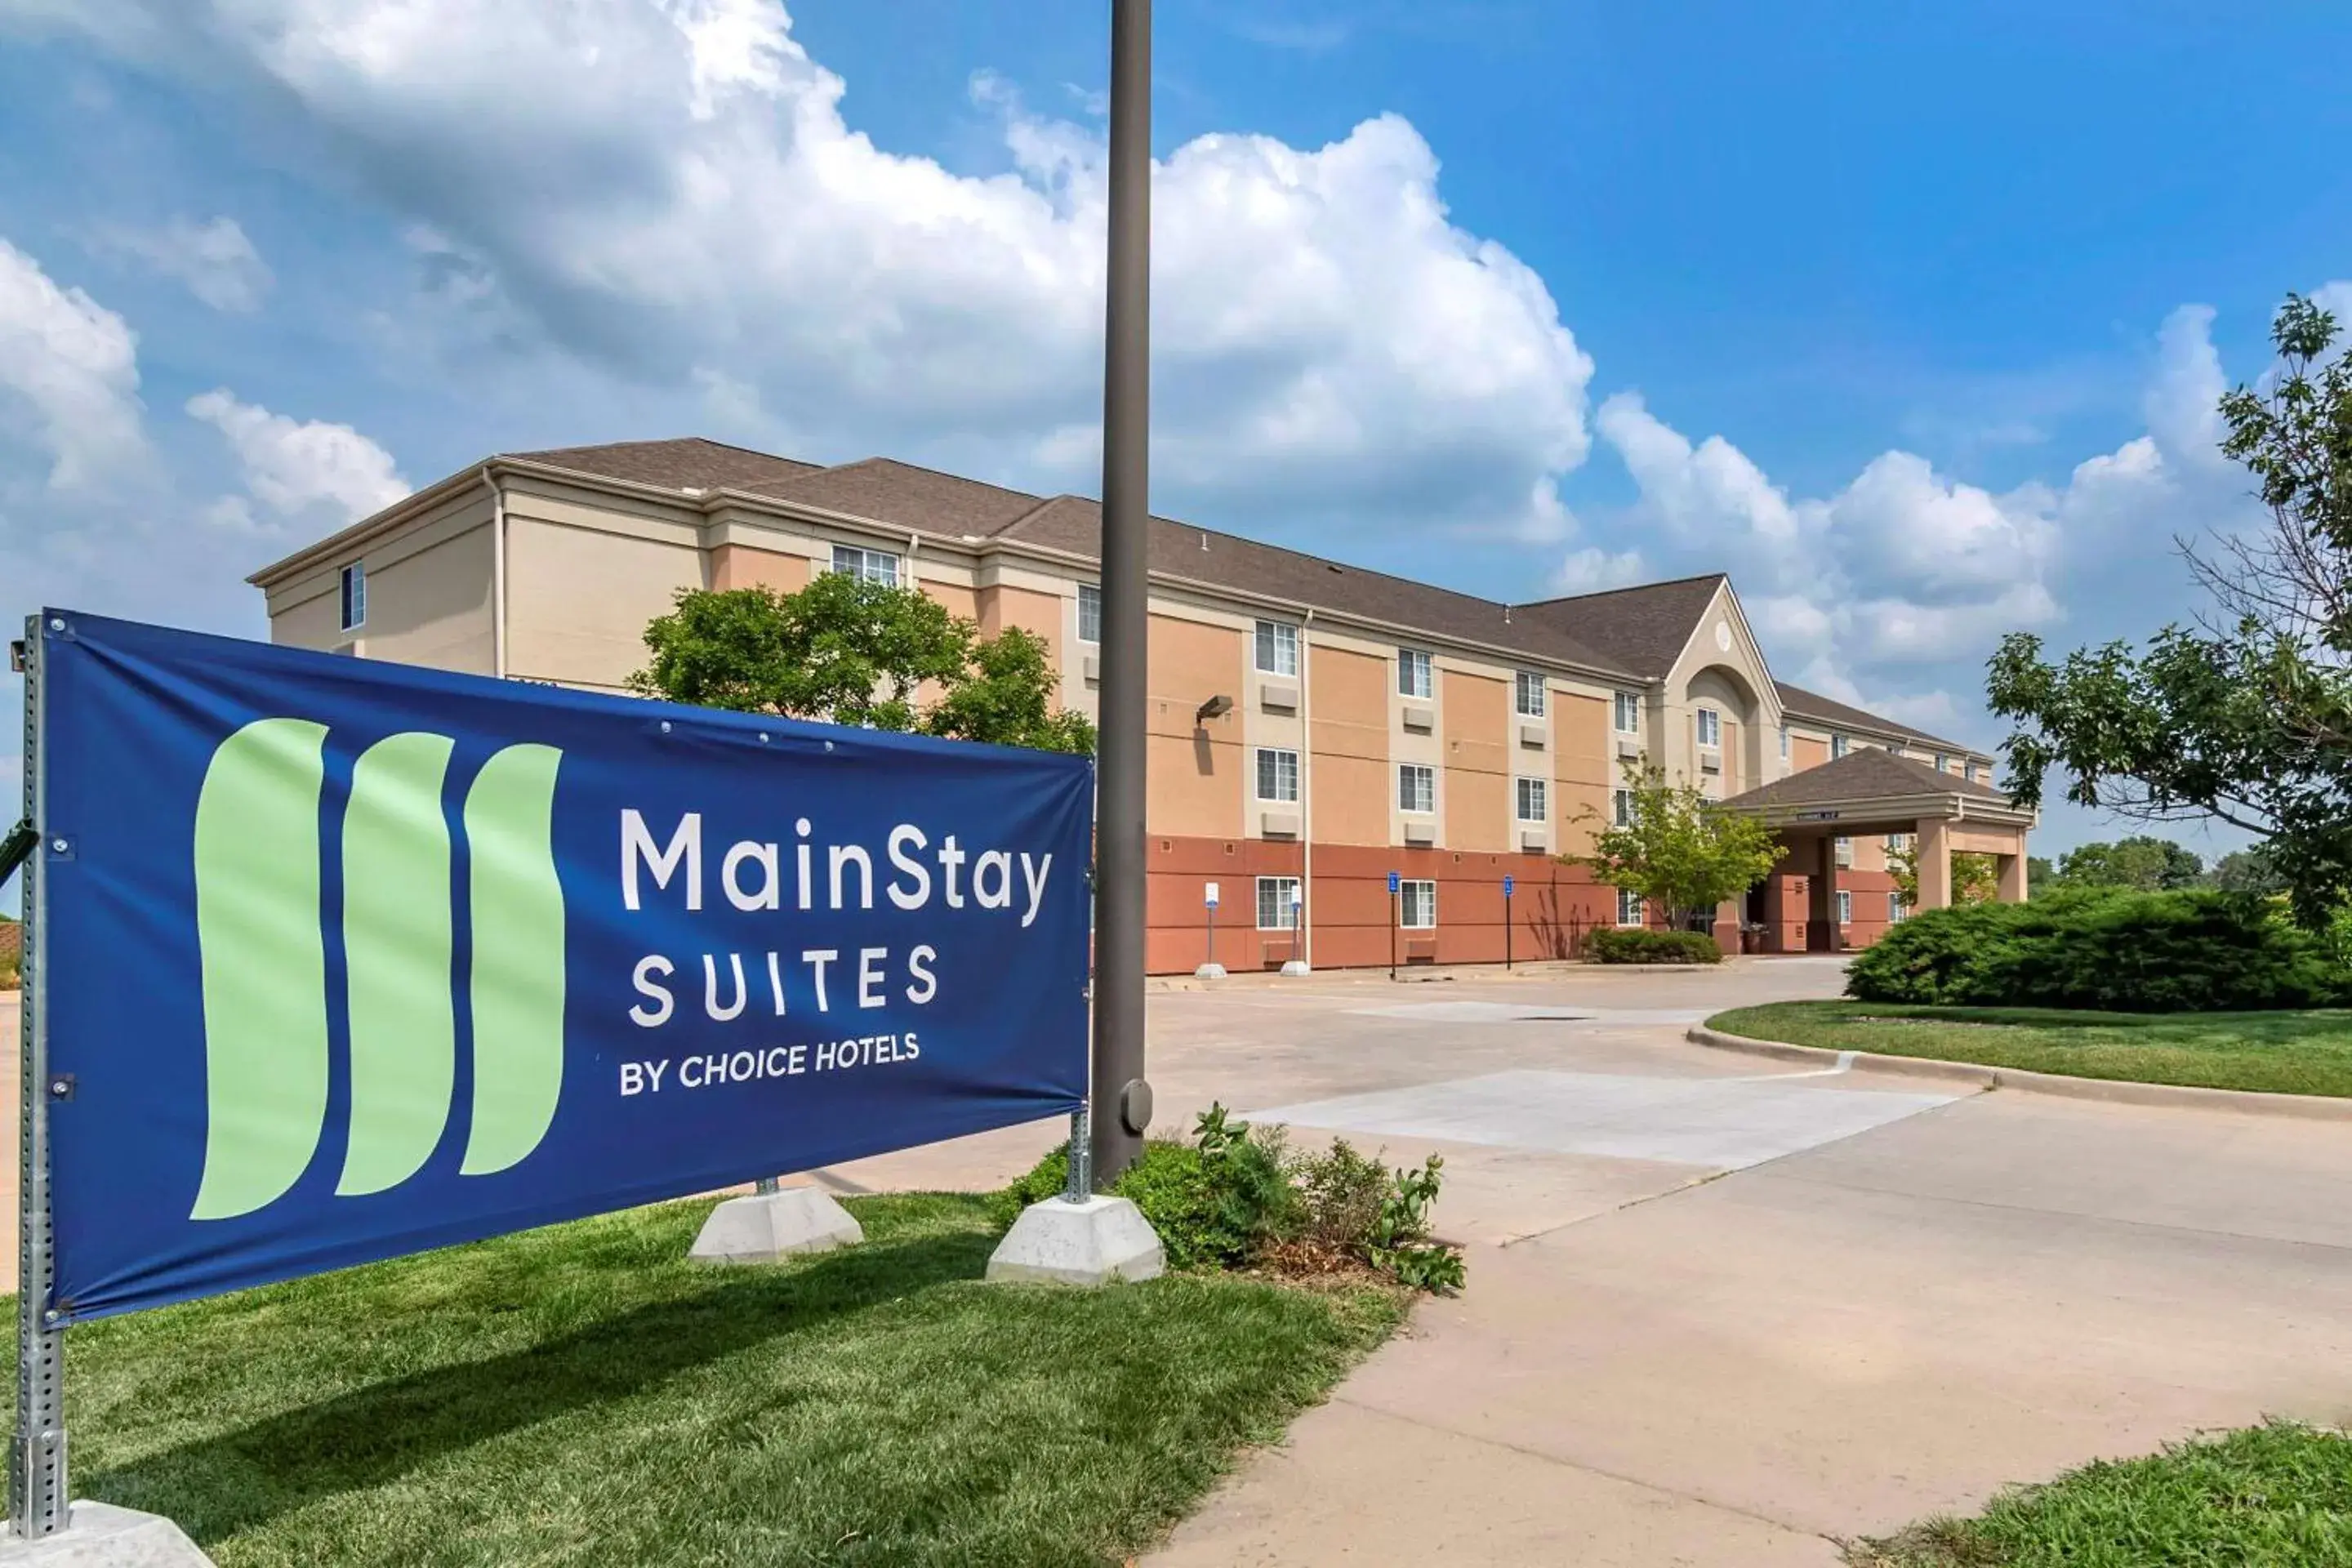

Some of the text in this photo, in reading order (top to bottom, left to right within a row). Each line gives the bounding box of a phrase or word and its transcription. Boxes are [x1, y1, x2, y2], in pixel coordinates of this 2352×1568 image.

[620, 808, 1053, 929] MainStay
[628, 945, 938, 1027] SUITES
[620, 1032, 920, 1096] BY CHOICE HOTELS
